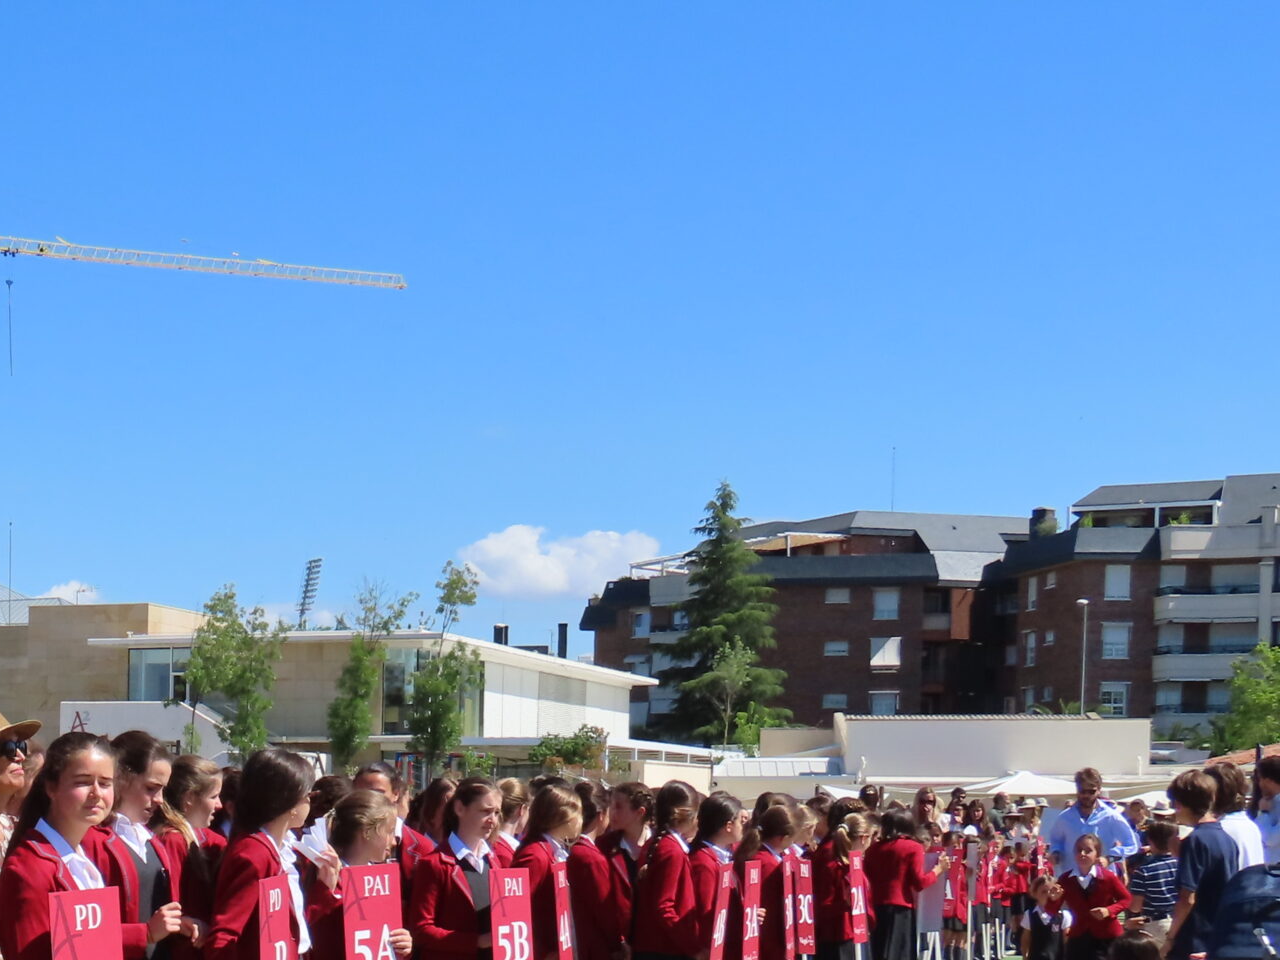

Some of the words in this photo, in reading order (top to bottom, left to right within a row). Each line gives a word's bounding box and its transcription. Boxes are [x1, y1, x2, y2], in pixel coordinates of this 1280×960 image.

[363, 874, 390, 896] PAI
[504, 877, 523, 896] PAI
[269, 888, 282, 912] PD
[798, 894, 813, 924] 3C
[851, 885, 865, 915] 2A
[74, 903, 102, 931] PD
[744, 904, 759, 940] 3A
